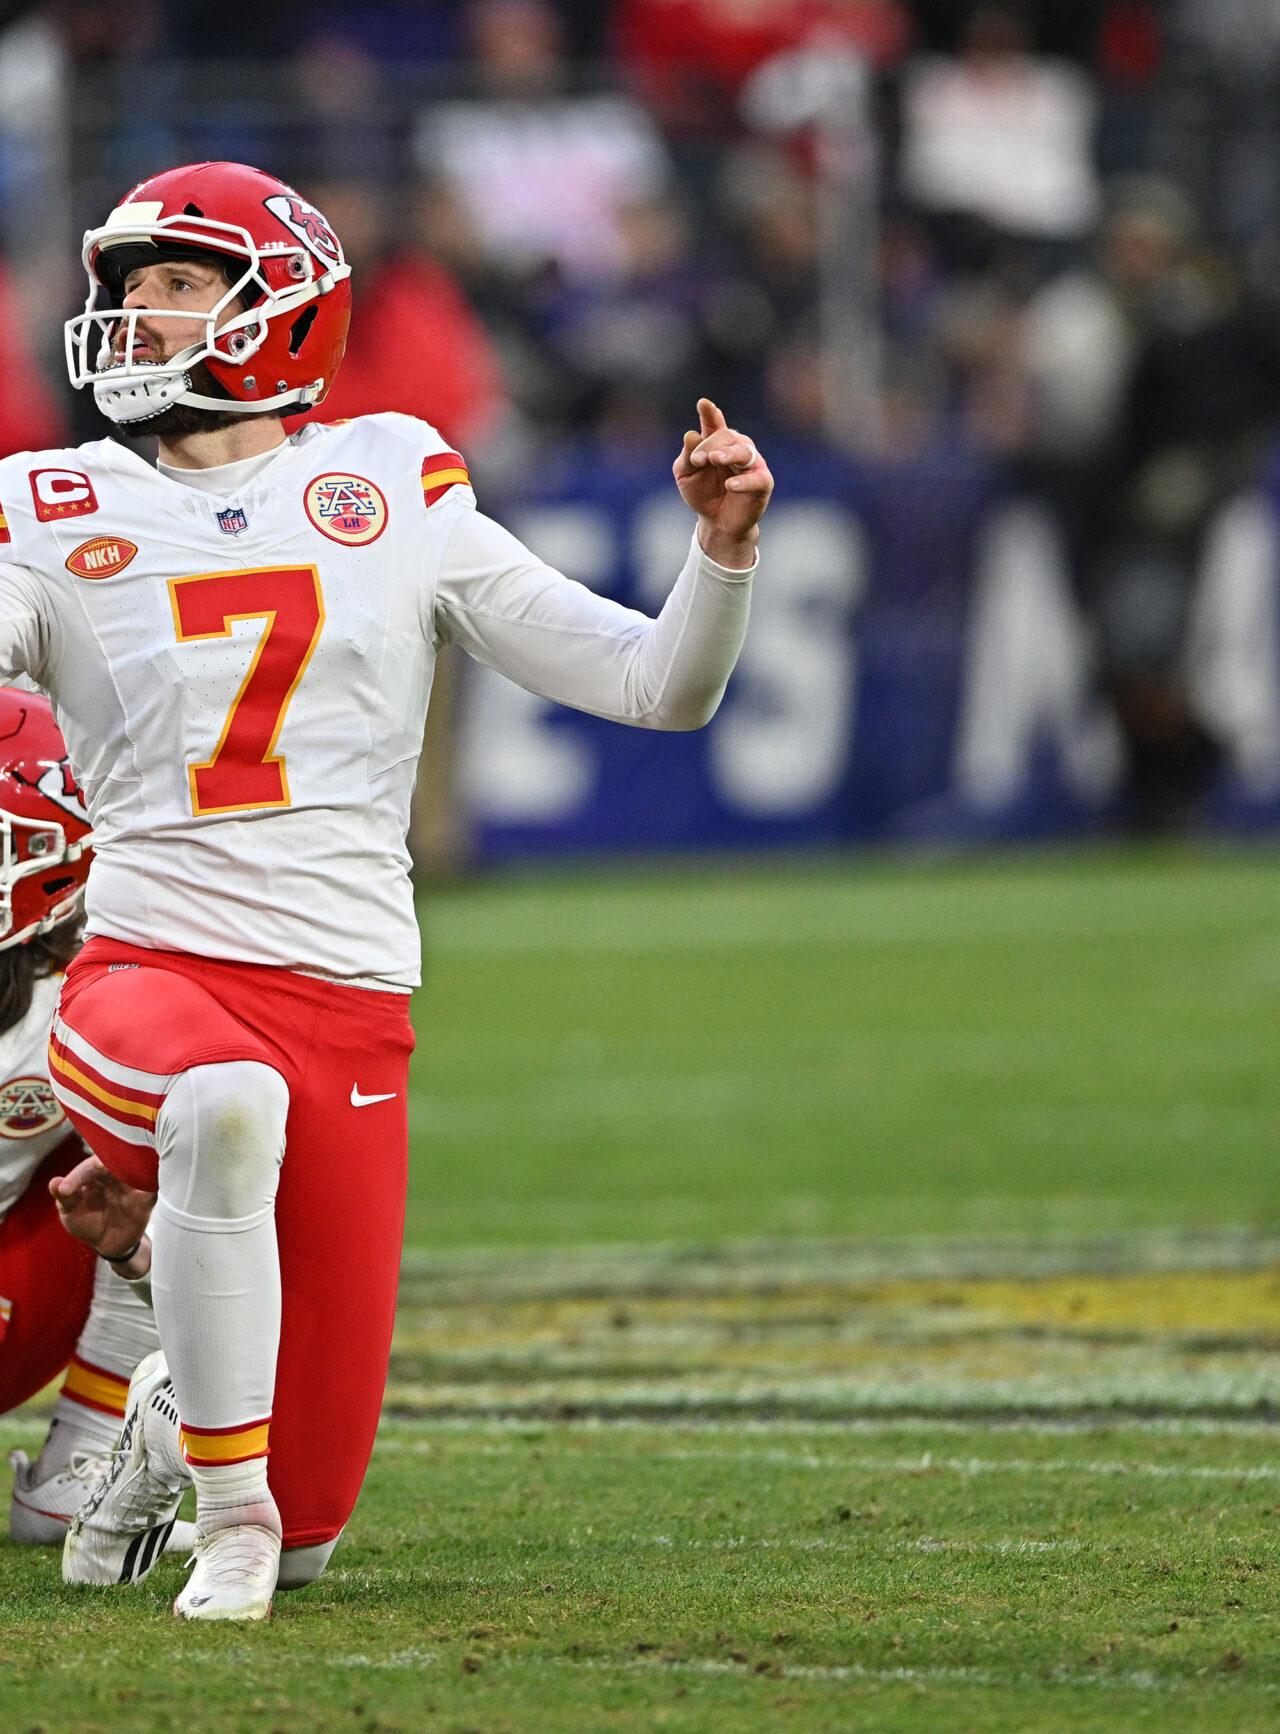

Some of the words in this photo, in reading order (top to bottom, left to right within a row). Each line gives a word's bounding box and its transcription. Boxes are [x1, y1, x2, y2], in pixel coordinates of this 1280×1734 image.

[35, 471, 90, 505] C
[319, 482, 376, 517] A
[221, 517, 246, 532] NFL
[342, 517, 361, 528] LH
[82, 544, 121, 571] NKH
[167, 563, 327, 817] 7
